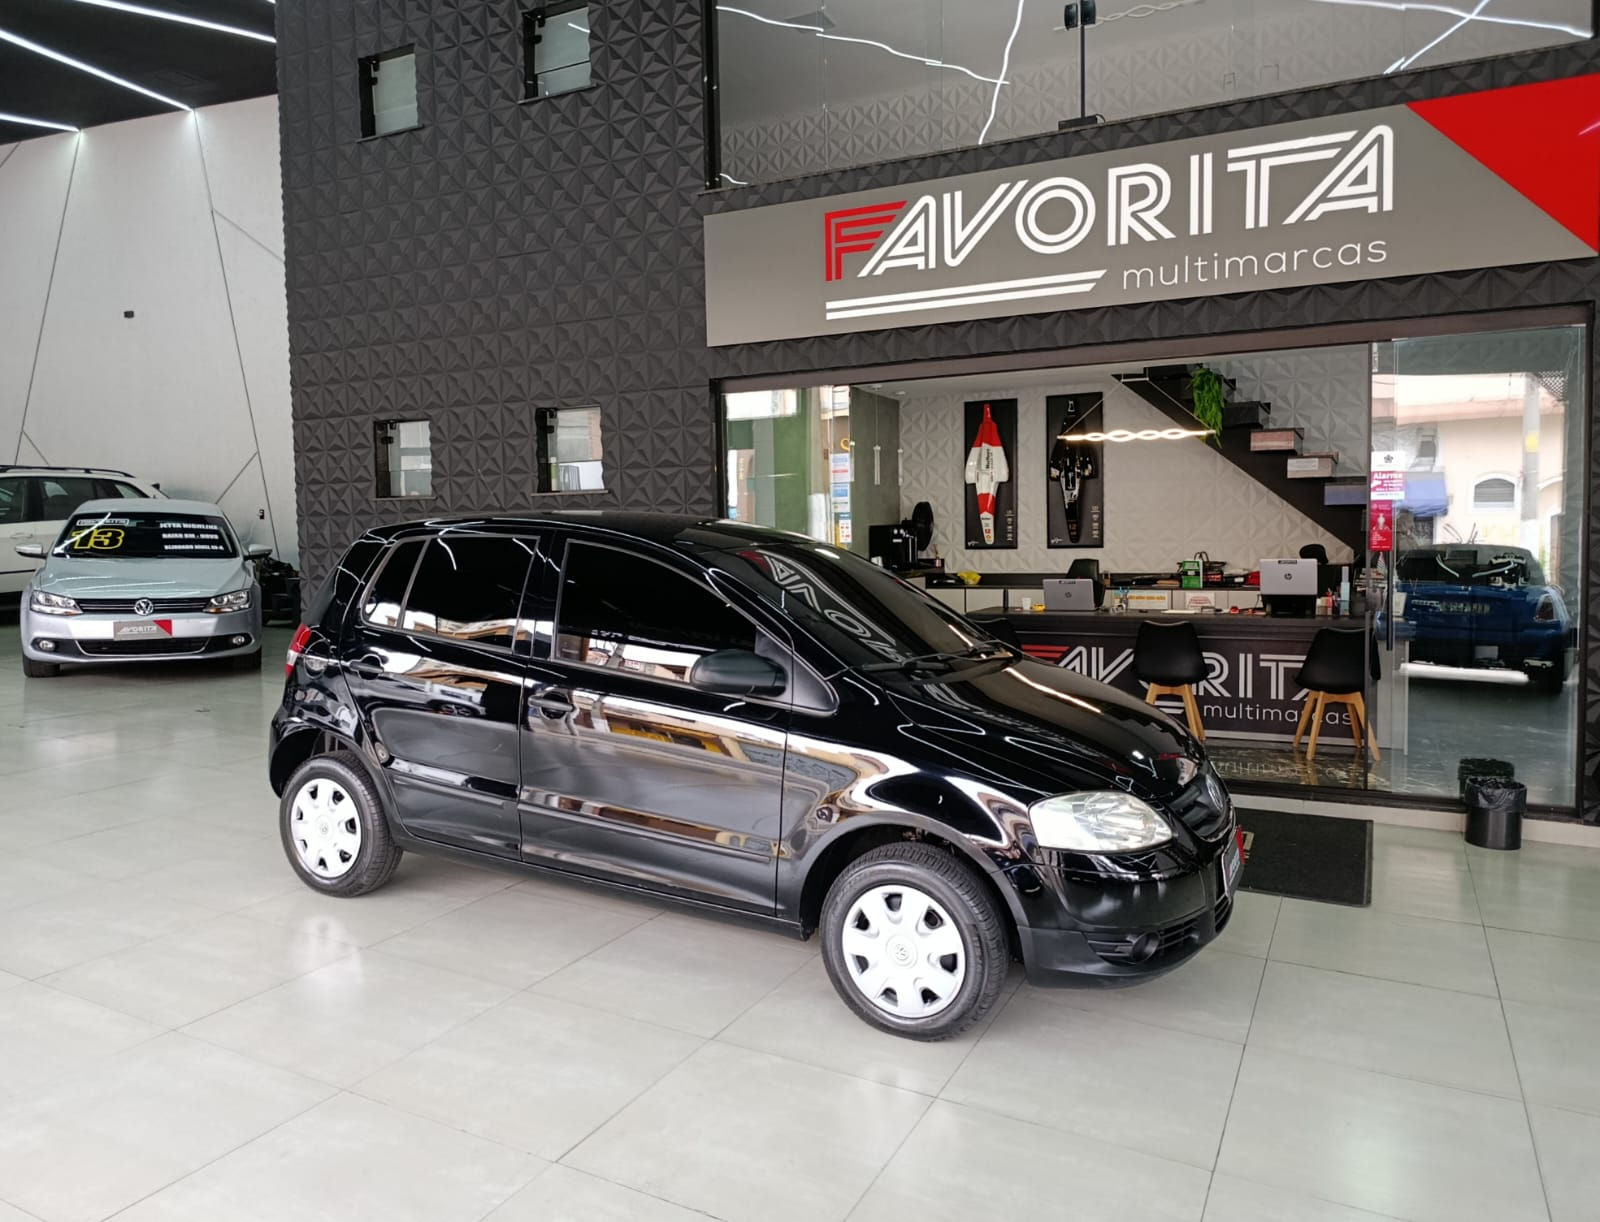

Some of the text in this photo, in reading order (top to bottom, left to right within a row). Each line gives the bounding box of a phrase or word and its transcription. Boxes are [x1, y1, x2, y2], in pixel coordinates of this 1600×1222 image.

[824, 125, 1394, 281] FAVORITA
[1122, 240, 1387, 290] multimarcas
[71, 528, 125, 549] 13
[1021, 644, 1309, 701] FAVRIT
[1203, 703, 1353, 726] multimacas
